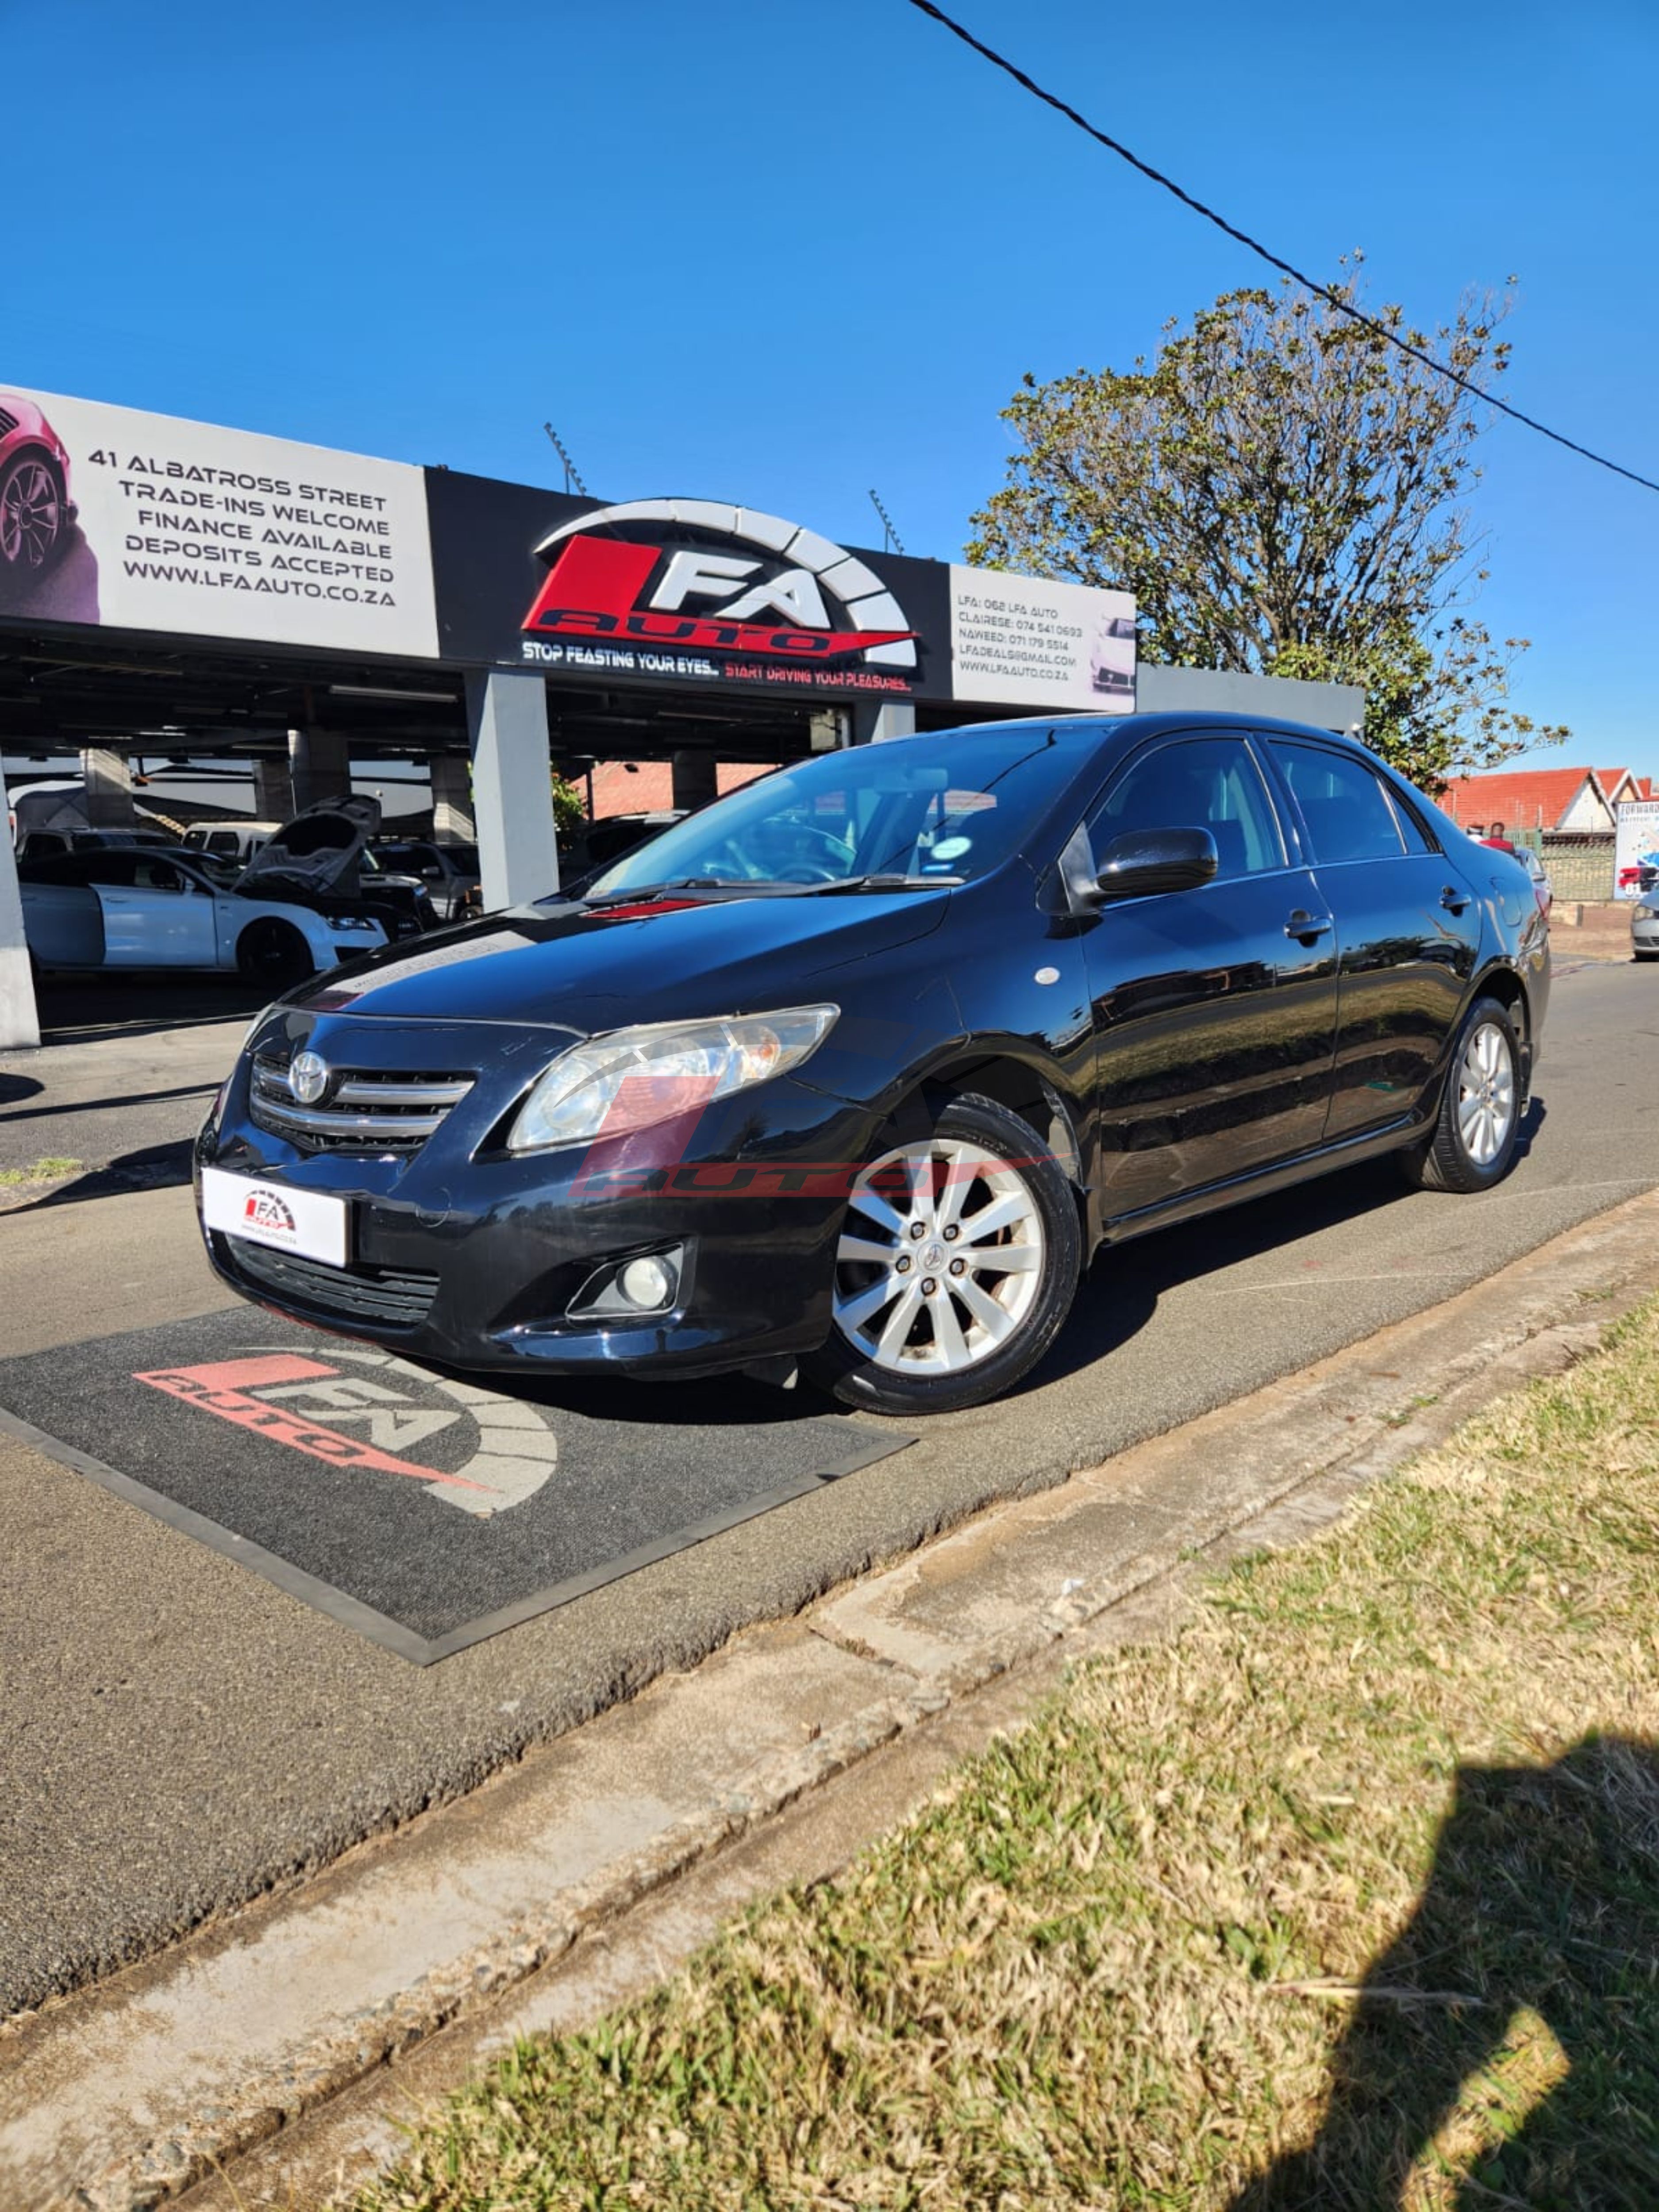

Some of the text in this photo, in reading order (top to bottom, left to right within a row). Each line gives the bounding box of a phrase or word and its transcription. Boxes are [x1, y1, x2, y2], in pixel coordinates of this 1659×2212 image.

[88, 450, 387, 511] 41 ALBATROSS STREET
[119, 480, 390, 535] TRADE-INS WELCOME
[139, 510, 393, 559] FINANCE AVAILABLE
[126, 535, 394, 583] DEPOSITS ACCEPTED
[123, 561, 396, 606] WWW.LFAAUTO.CO.ZA
[539, 609, 830, 651] AUTO
[958, 596, 1058, 619] LFA: 062 LFA AUTO
[1016, 620, 1035, 631] 074
[959, 629, 1005, 642] NAWEED:
[522, 641, 563, 662] STOP
[566, 645, 634, 668] FEASTING
[636, 653, 675, 673] YOUR
[725, 662, 763, 679] START
[767, 666, 812, 684] DRIVING
[815, 671, 843, 685] YOUR
[146, 1373, 366, 1457] AUTO
